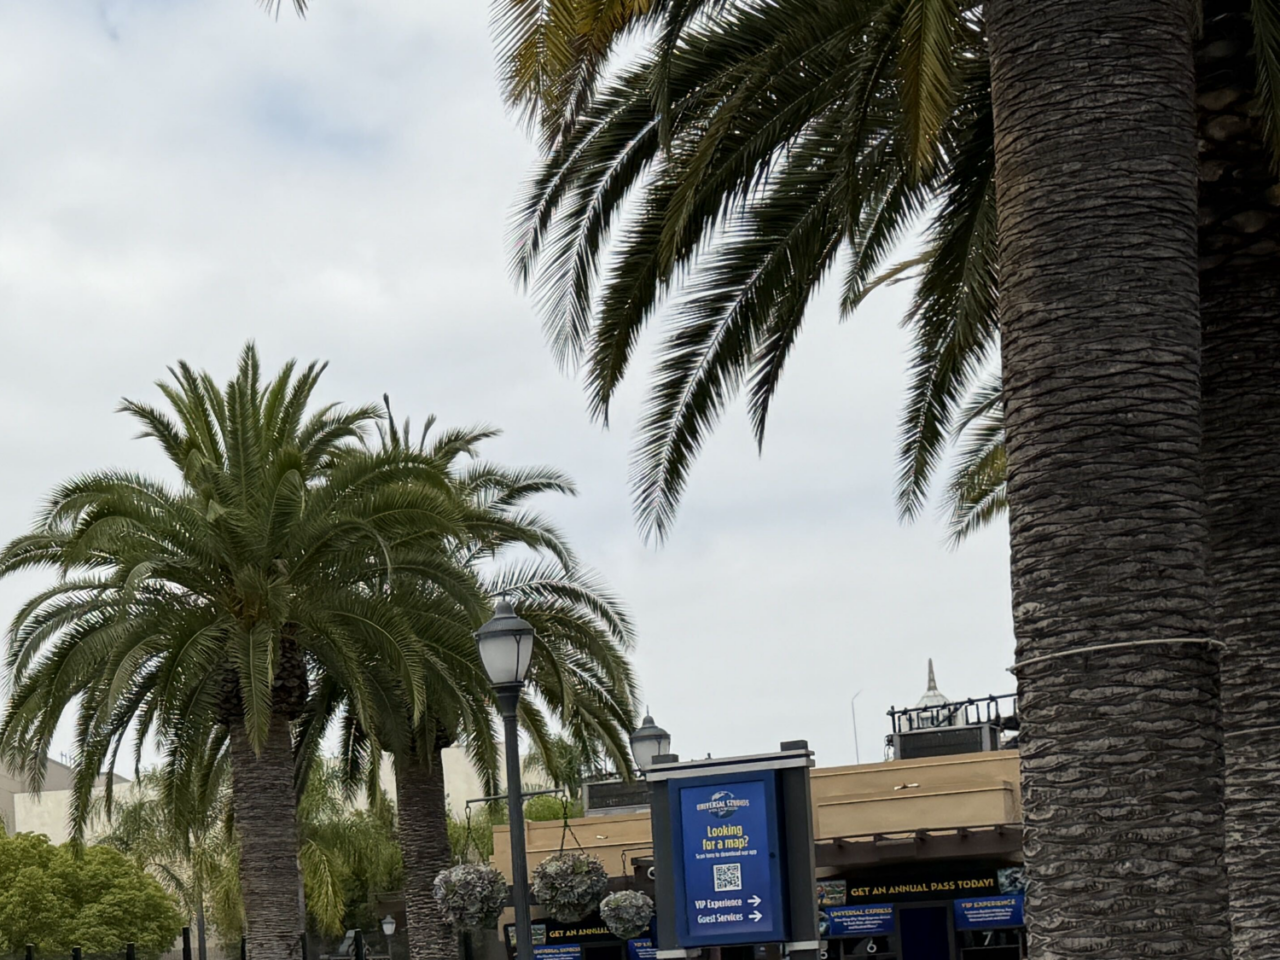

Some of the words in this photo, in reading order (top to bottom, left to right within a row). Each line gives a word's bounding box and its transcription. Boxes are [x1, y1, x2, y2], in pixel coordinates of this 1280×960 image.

[707, 824, 742, 837] Looking
[702, 839, 716, 850] for
[717, 841, 723, 849] a
[725, 836, 749, 849] map?
[851, 887, 870, 896] GET
[872, 886, 886, 895] AN
[888, 883, 928, 894] ANNUAL
[931, 880, 955, 891] PASS
[957, 878, 994, 889] TODAY!
[695, 901, 706, 909] VIP
[707, 898, 742, 909] Experience
[697, 914, 716, 924] Guest
[716, 912, 743, 923] Services
[578, 926, 609, 936] ANNUAL
[867, 936, 877, 953] 6
[982, 931, 993, 946] 7
